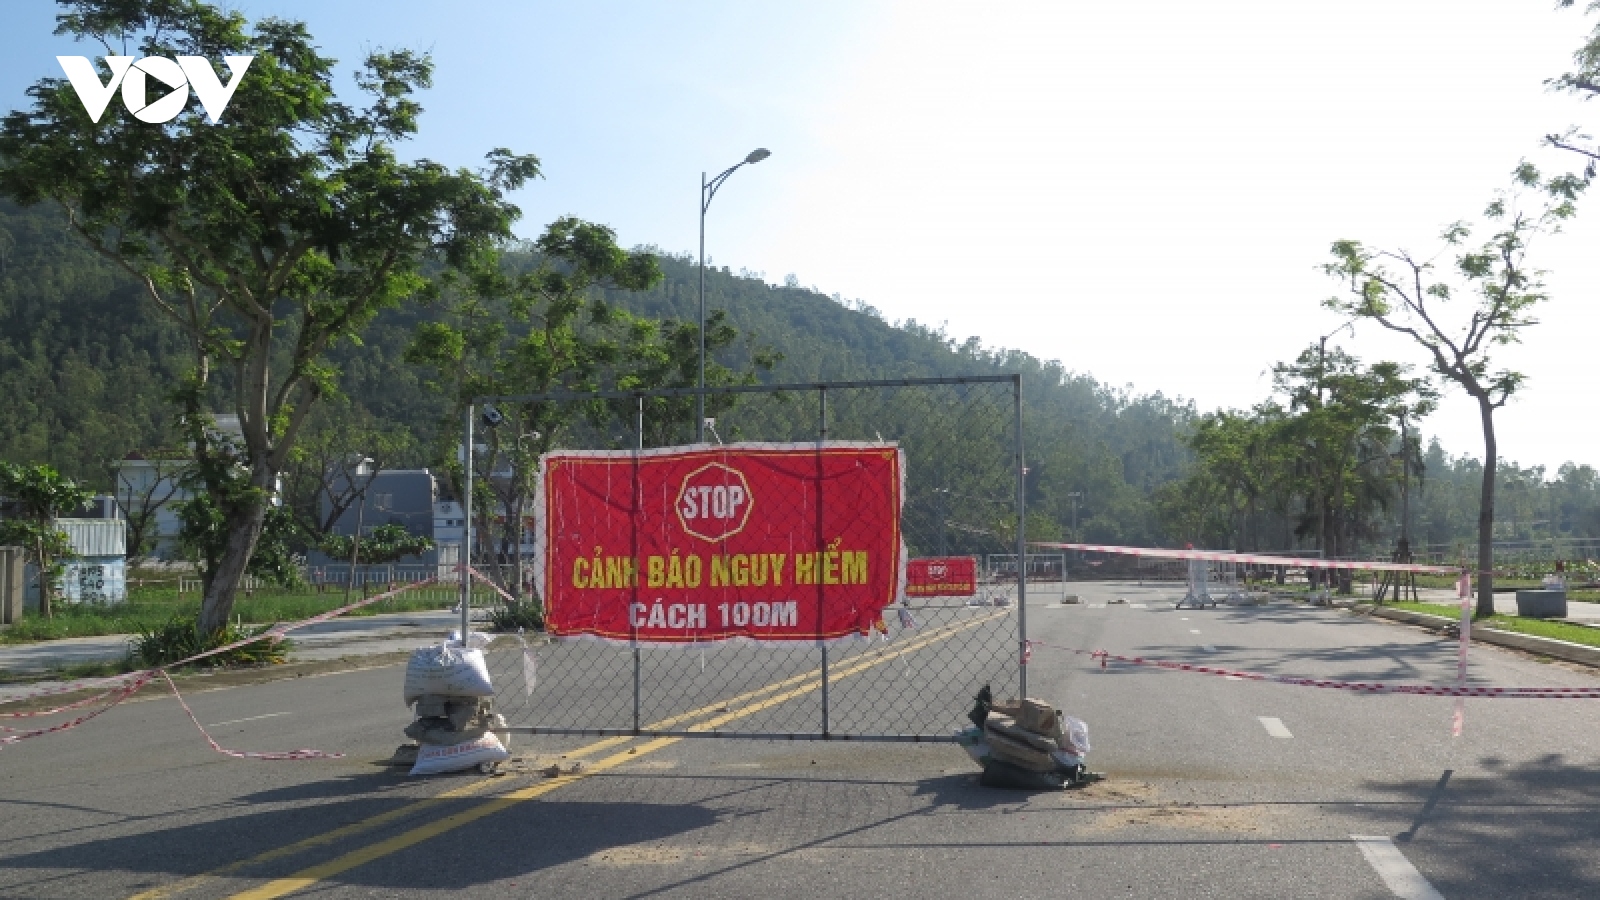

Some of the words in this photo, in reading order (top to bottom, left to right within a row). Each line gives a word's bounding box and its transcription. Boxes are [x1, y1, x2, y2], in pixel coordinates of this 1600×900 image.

[682, 484, 744, 520] STOP
[573, 545, 639, 589] CẢNH
[648, 550, 703, 588] BÁO
[710, 552, 786, 587] NGUY
[795, 537, 868, 585] HIỂM
[629, 598, 707, 629] CÁCH
[717, 600, 798, 628] 100M
